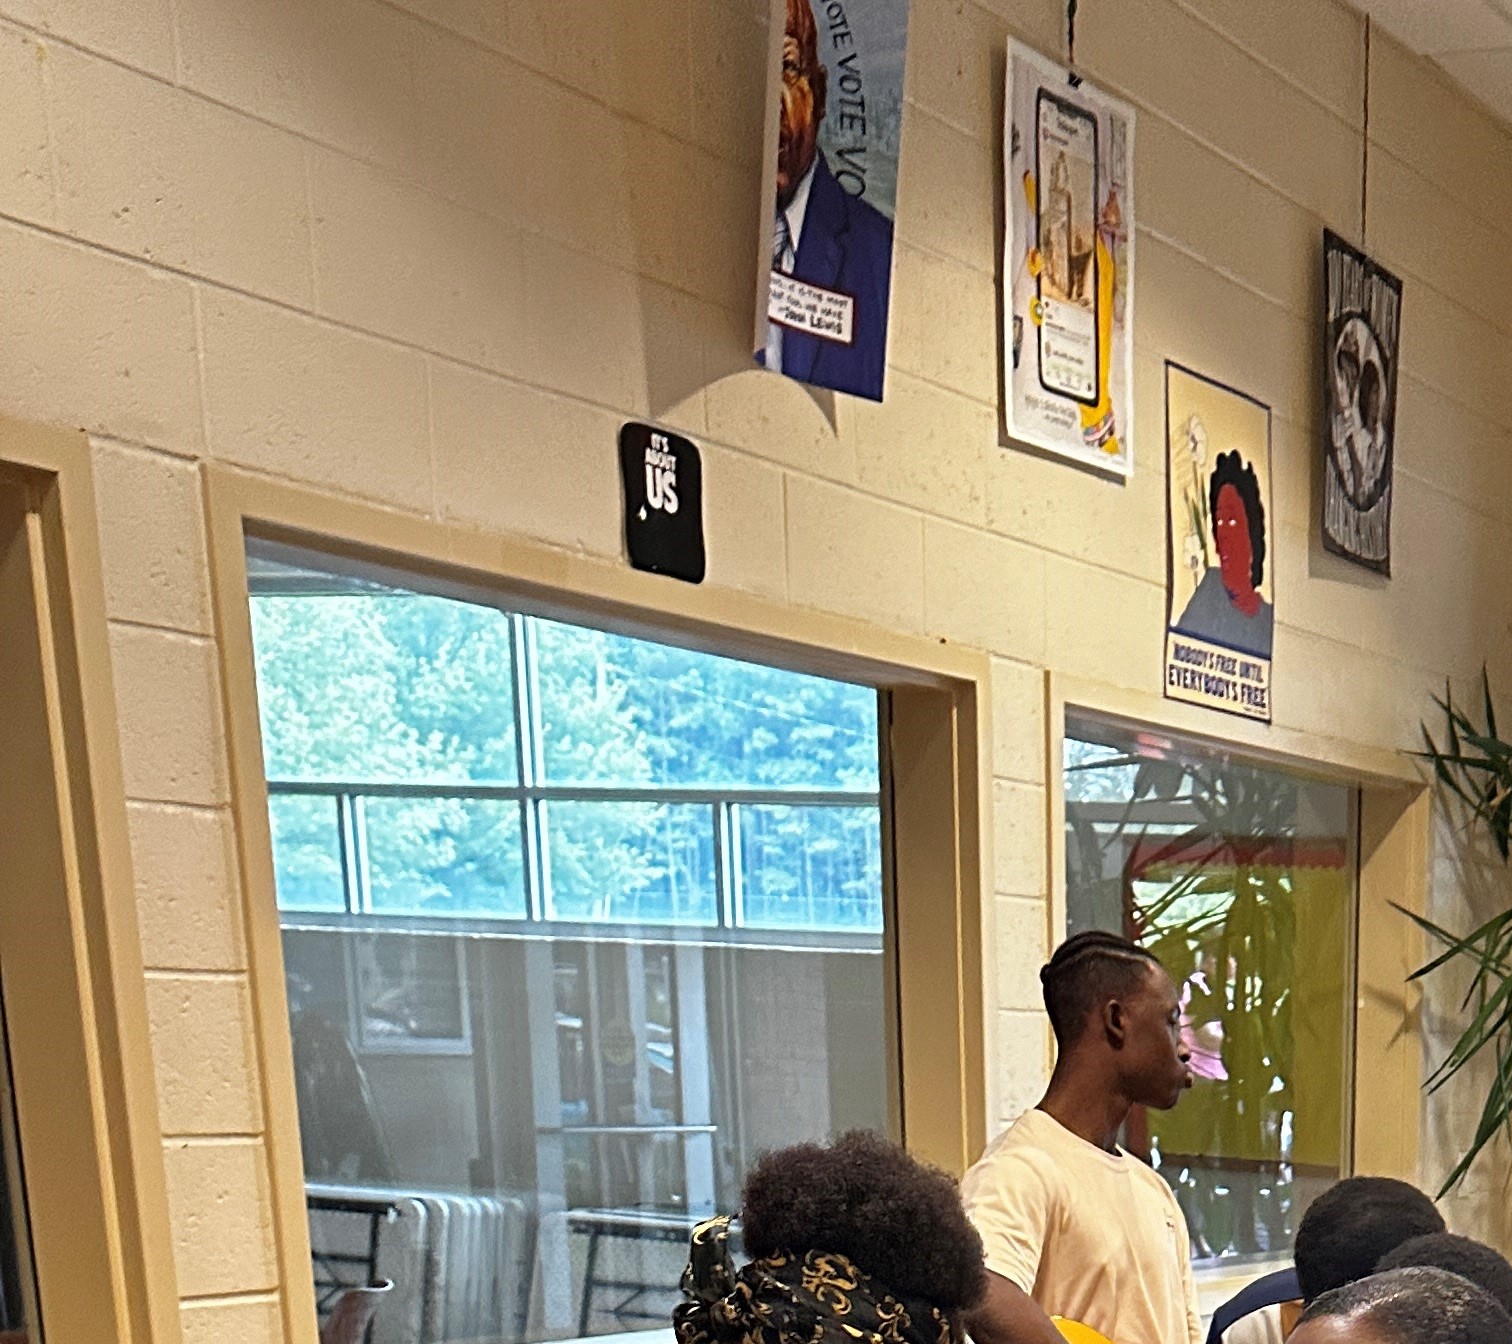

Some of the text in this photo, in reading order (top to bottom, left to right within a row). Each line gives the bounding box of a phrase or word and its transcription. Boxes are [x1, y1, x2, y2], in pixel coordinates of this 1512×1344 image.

[820, 0, 867, 199] OTE VOTE VO
[645, 463, 679, 514] US
[1169, 663, 1267, 709] EVERYBODY'S FREE
